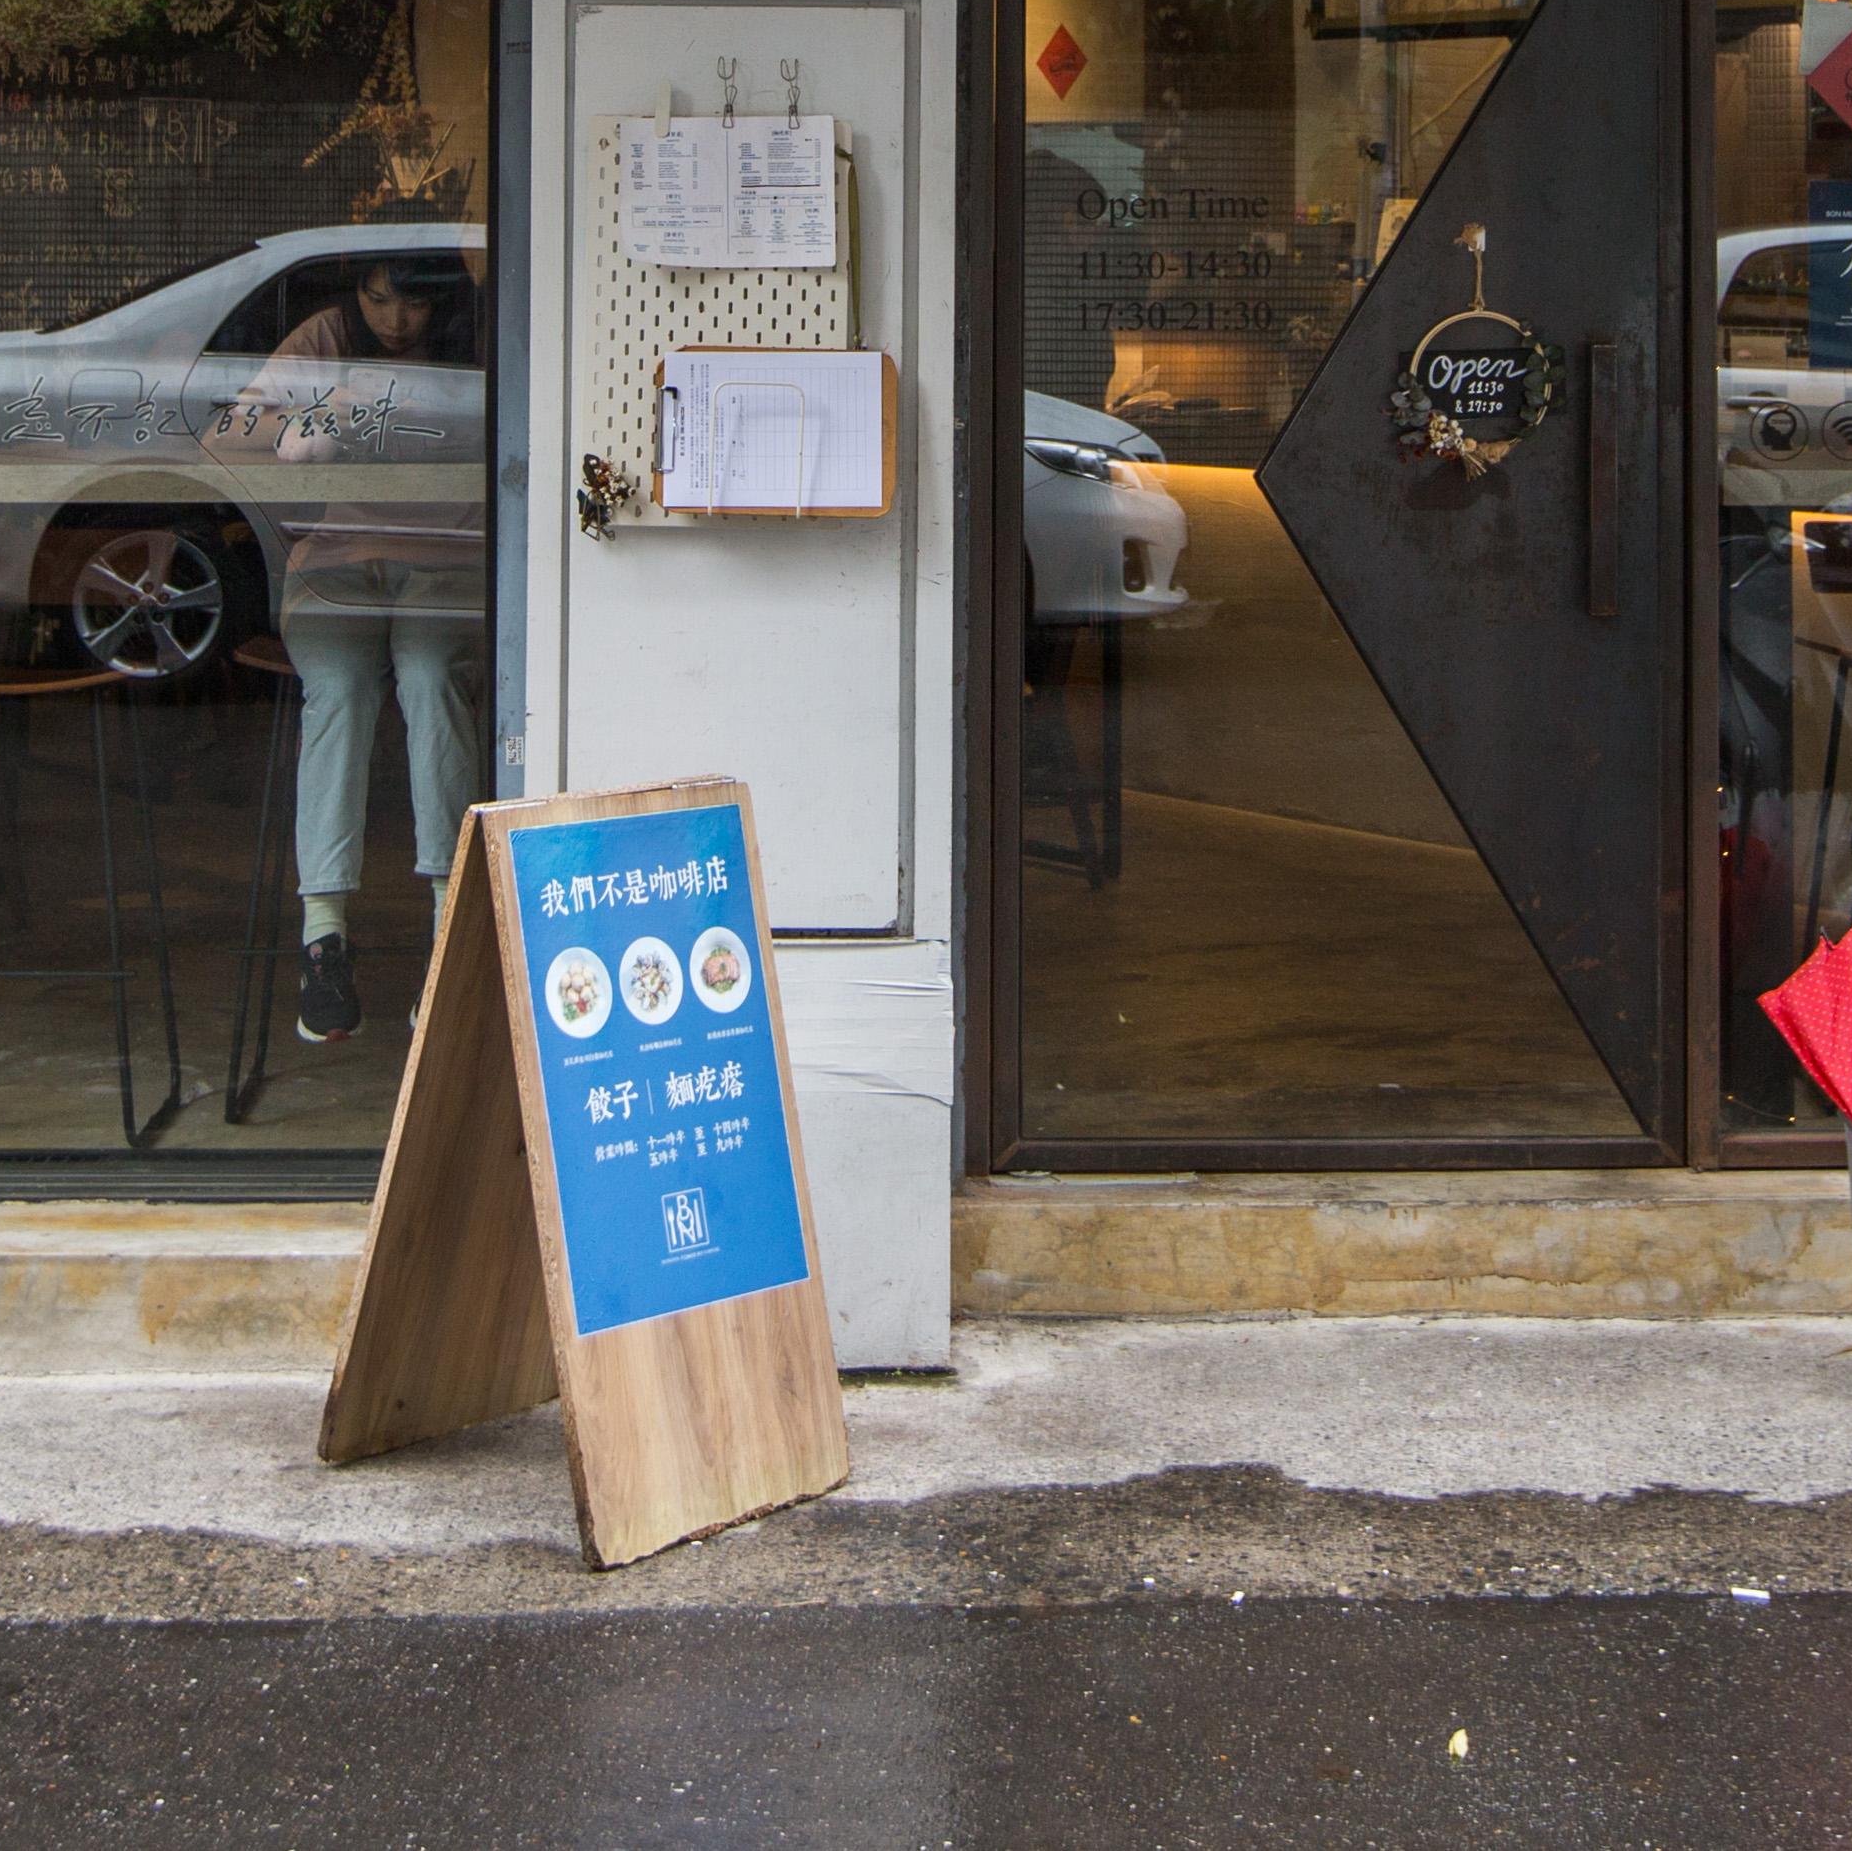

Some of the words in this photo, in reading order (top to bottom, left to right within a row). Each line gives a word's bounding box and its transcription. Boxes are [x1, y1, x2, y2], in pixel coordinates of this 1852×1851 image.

[1076, 188, 1169, 228] Open
[1179, 187, 1270, 219] Time
[1076, 250, 1272, 280] 11:30-14:30
[1078, 301, 1273, 331] 17:30-21:30
[1429, 355, 1529, 394] Open
[1468, 381, 1505, 396] 11:30
[1455, 399, 1463, 414] &
[1467, 400, 1504, 414] 17:30
[540, 854, 729, 919] 我們不是咖啡店
[584, 1079, 639, 1125] 餃子
[664, 1060, 746, 1112] 麵疙瘩
[694, 1125, 706, 1141] 至
[697, 1142, 708, 1157] 至
